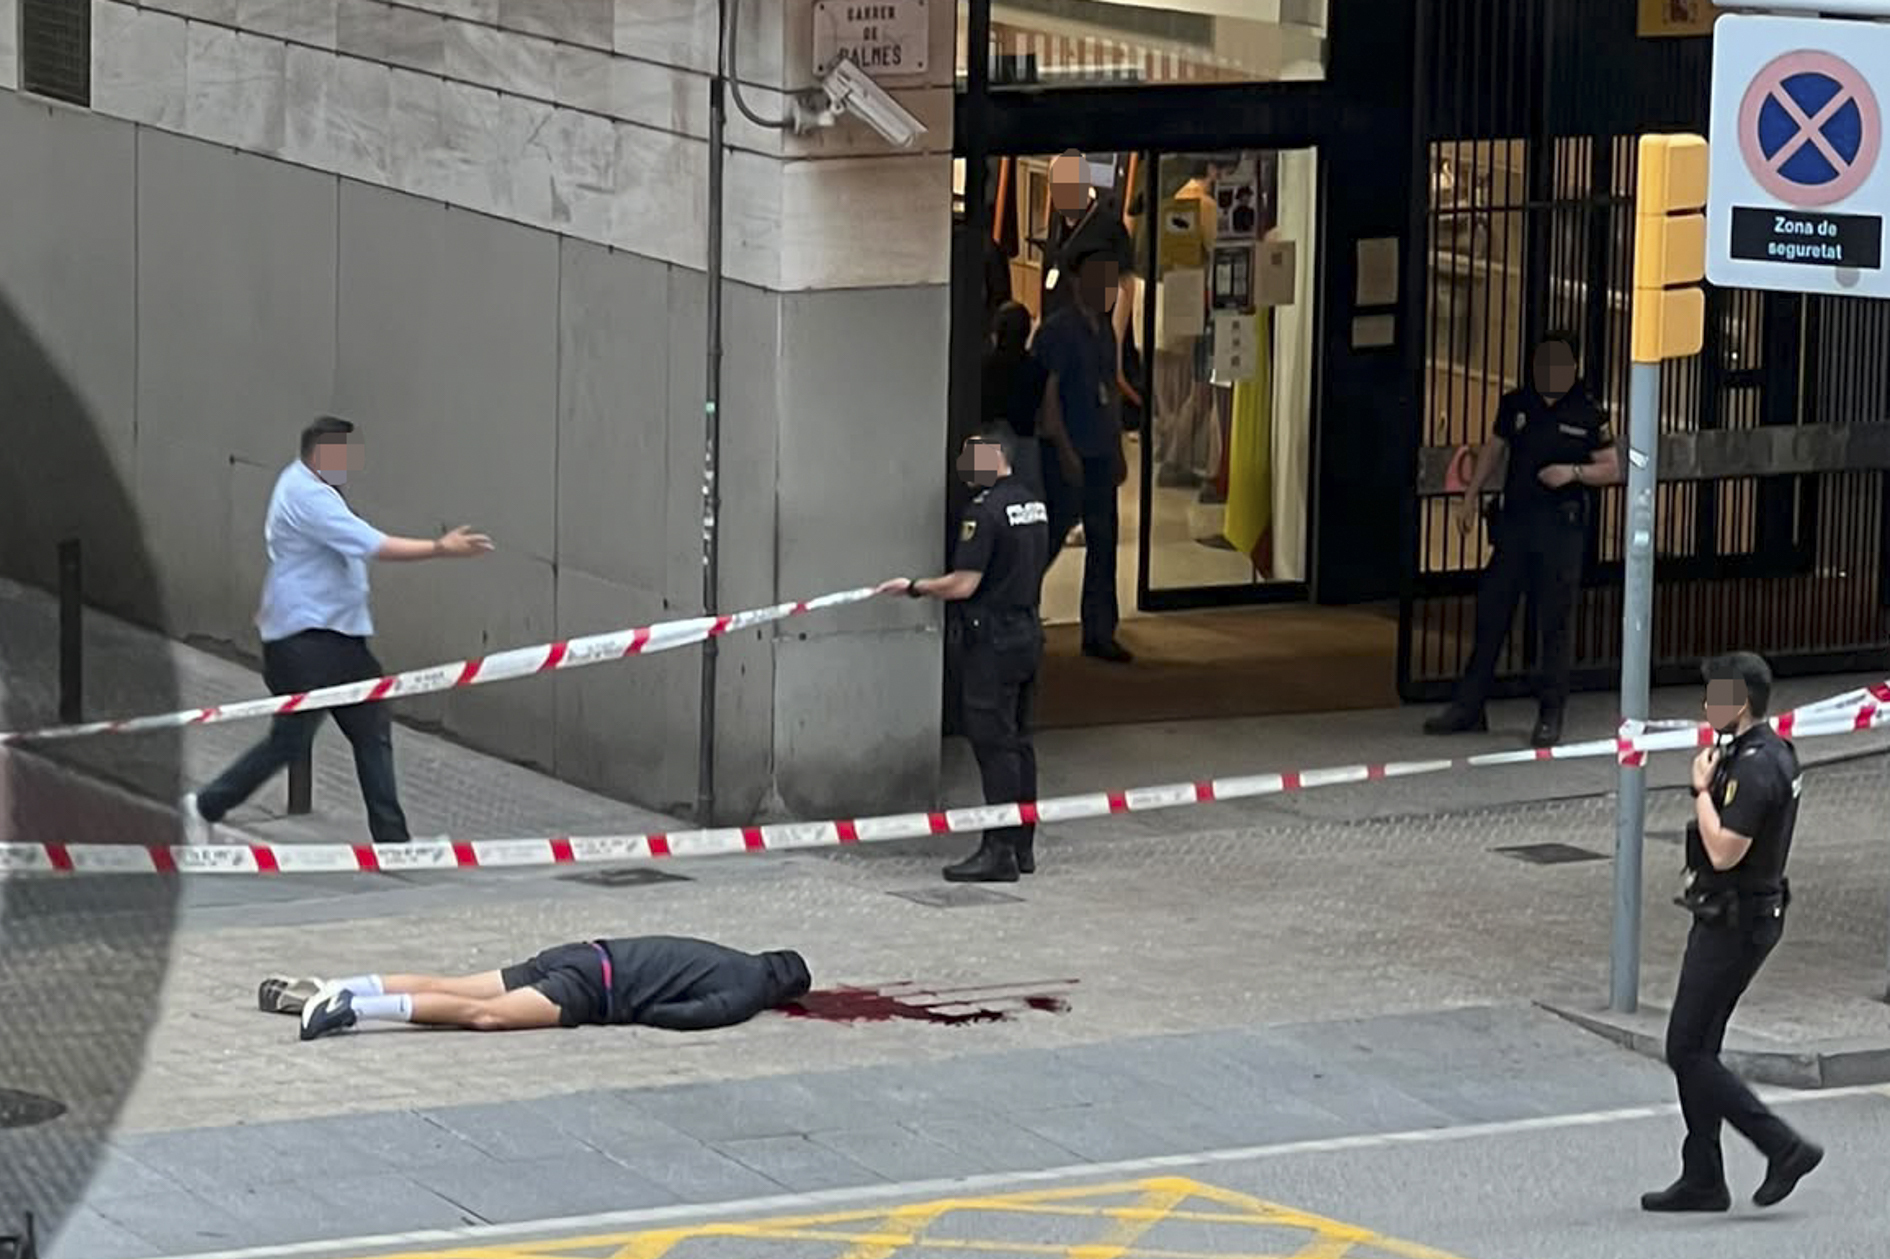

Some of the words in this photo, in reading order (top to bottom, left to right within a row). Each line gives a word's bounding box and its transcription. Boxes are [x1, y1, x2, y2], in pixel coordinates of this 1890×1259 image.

[863, 26, 878, 41] DE
[1774, 216, 1814, 235] Zona
[1817, 219, 1838, 237] de
[1768, 242, 1843, 260] seguretat
